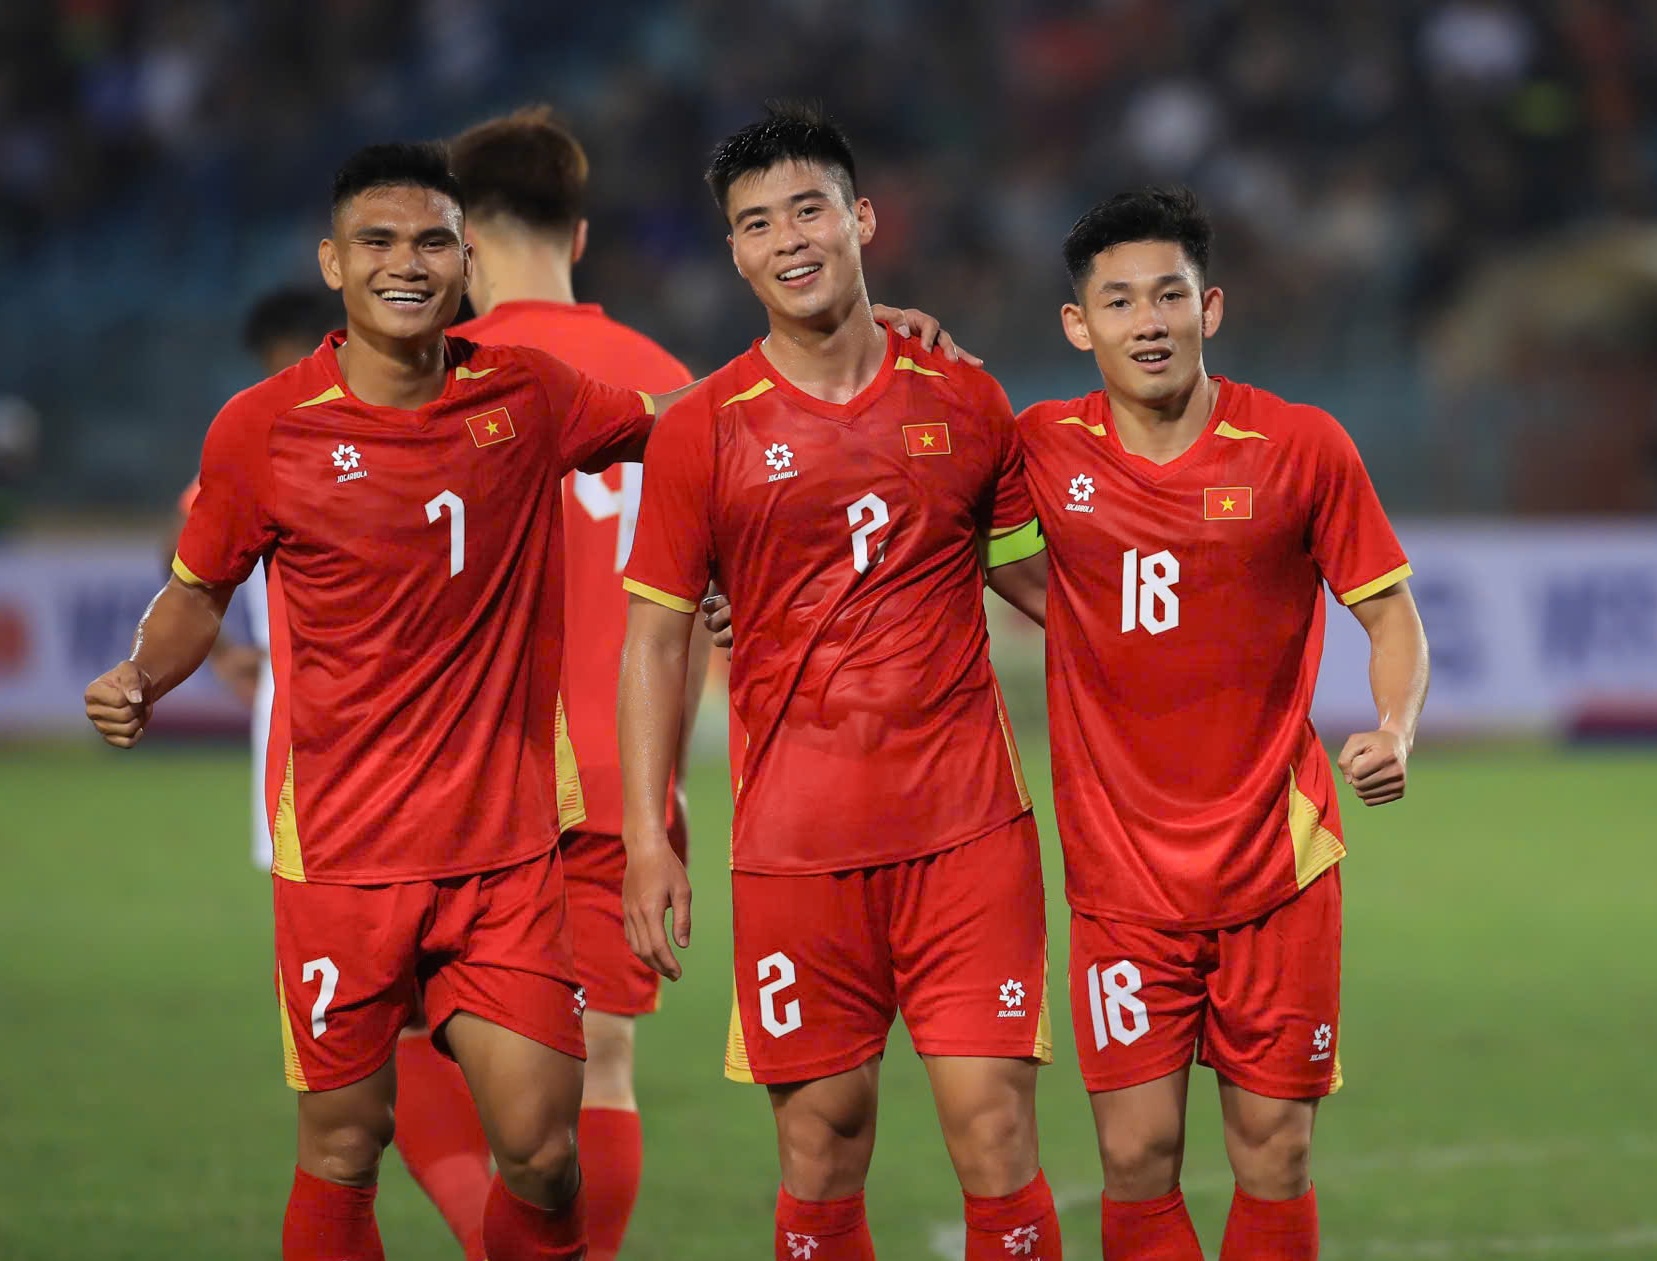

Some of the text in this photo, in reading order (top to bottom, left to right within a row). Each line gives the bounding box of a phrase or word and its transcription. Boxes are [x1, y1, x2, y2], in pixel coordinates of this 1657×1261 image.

[424, 489, 465, 577] 7
[846, 492, 890, 575] 2
[1121, 547, 1180, 636] 18
[302, 956, 340, 1039] 7
[757, 951, 802, 1039] 2
[1087, 959, 1151, 1052] 18
